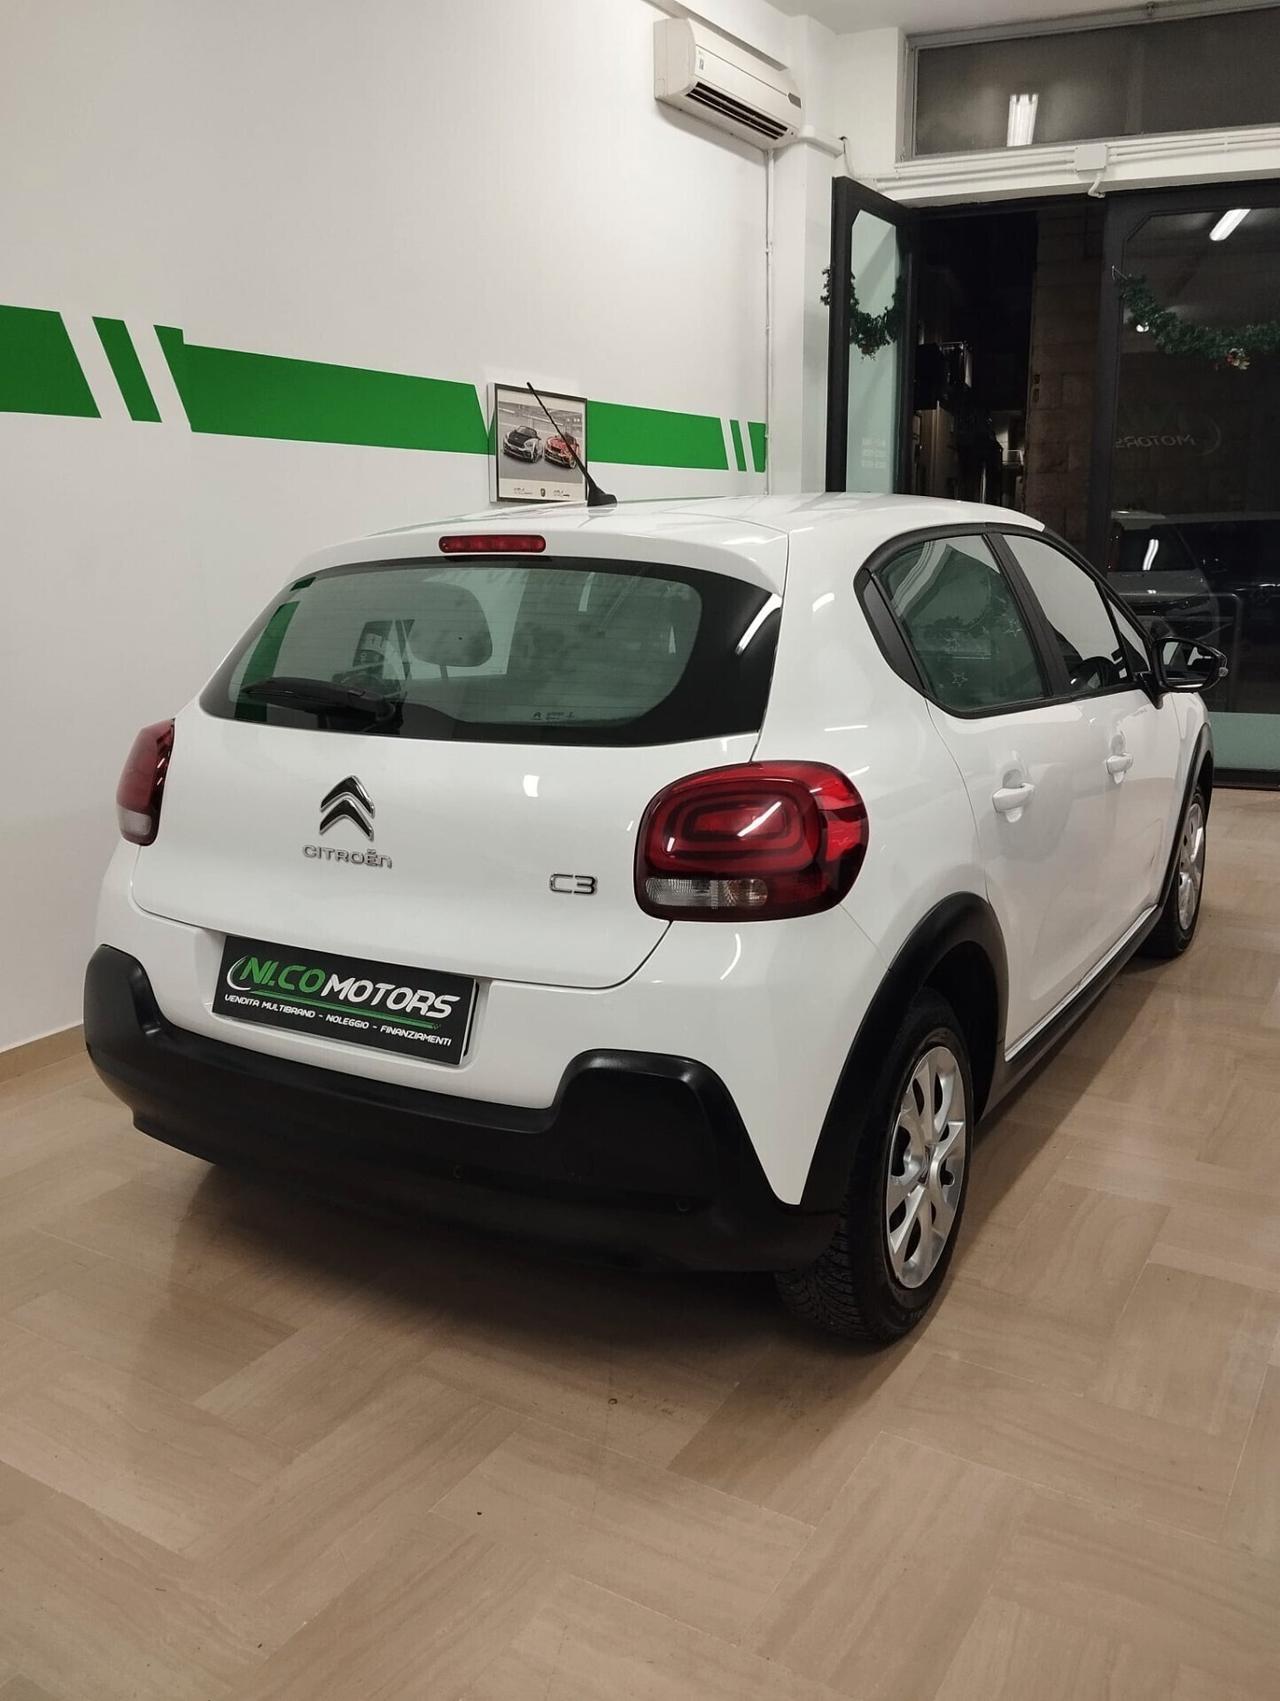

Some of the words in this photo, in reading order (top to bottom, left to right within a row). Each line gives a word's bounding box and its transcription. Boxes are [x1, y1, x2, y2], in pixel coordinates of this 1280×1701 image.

[549, 873, 598, 895] C3
[224, 994, 260, 1007] VENDITA
[261, 1001, 316, 1018] MULTIBRAND
[325, 1014, 370, 1030] NOLEGGIO
[380, 1025, 452, 1047] FINANZIAMENTI
